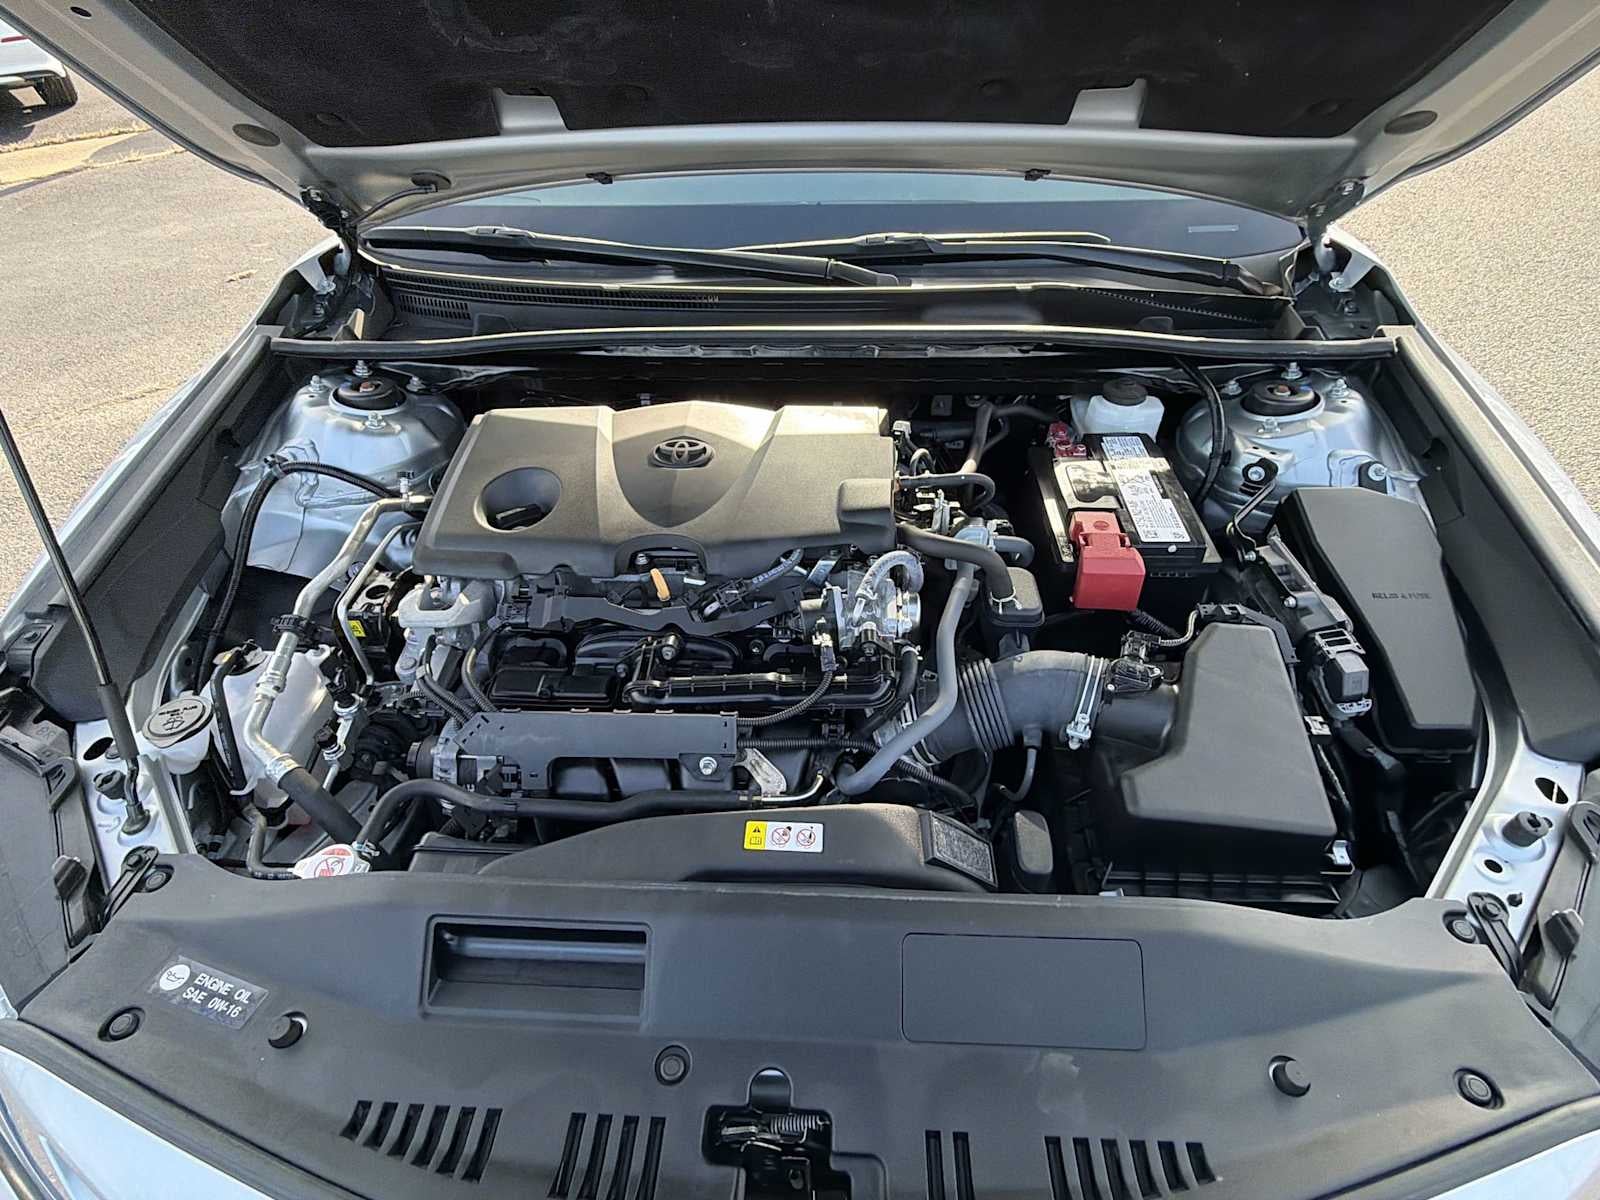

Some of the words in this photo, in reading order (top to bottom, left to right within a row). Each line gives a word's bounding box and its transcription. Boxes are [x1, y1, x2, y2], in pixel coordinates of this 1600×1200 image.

[182, 986, 208, 1004] SAE
[207, 997, 243, 1018] 0W-16
[194, 972, 235, 996] ENGINE
[233, 988, 253, 1004] OIL
